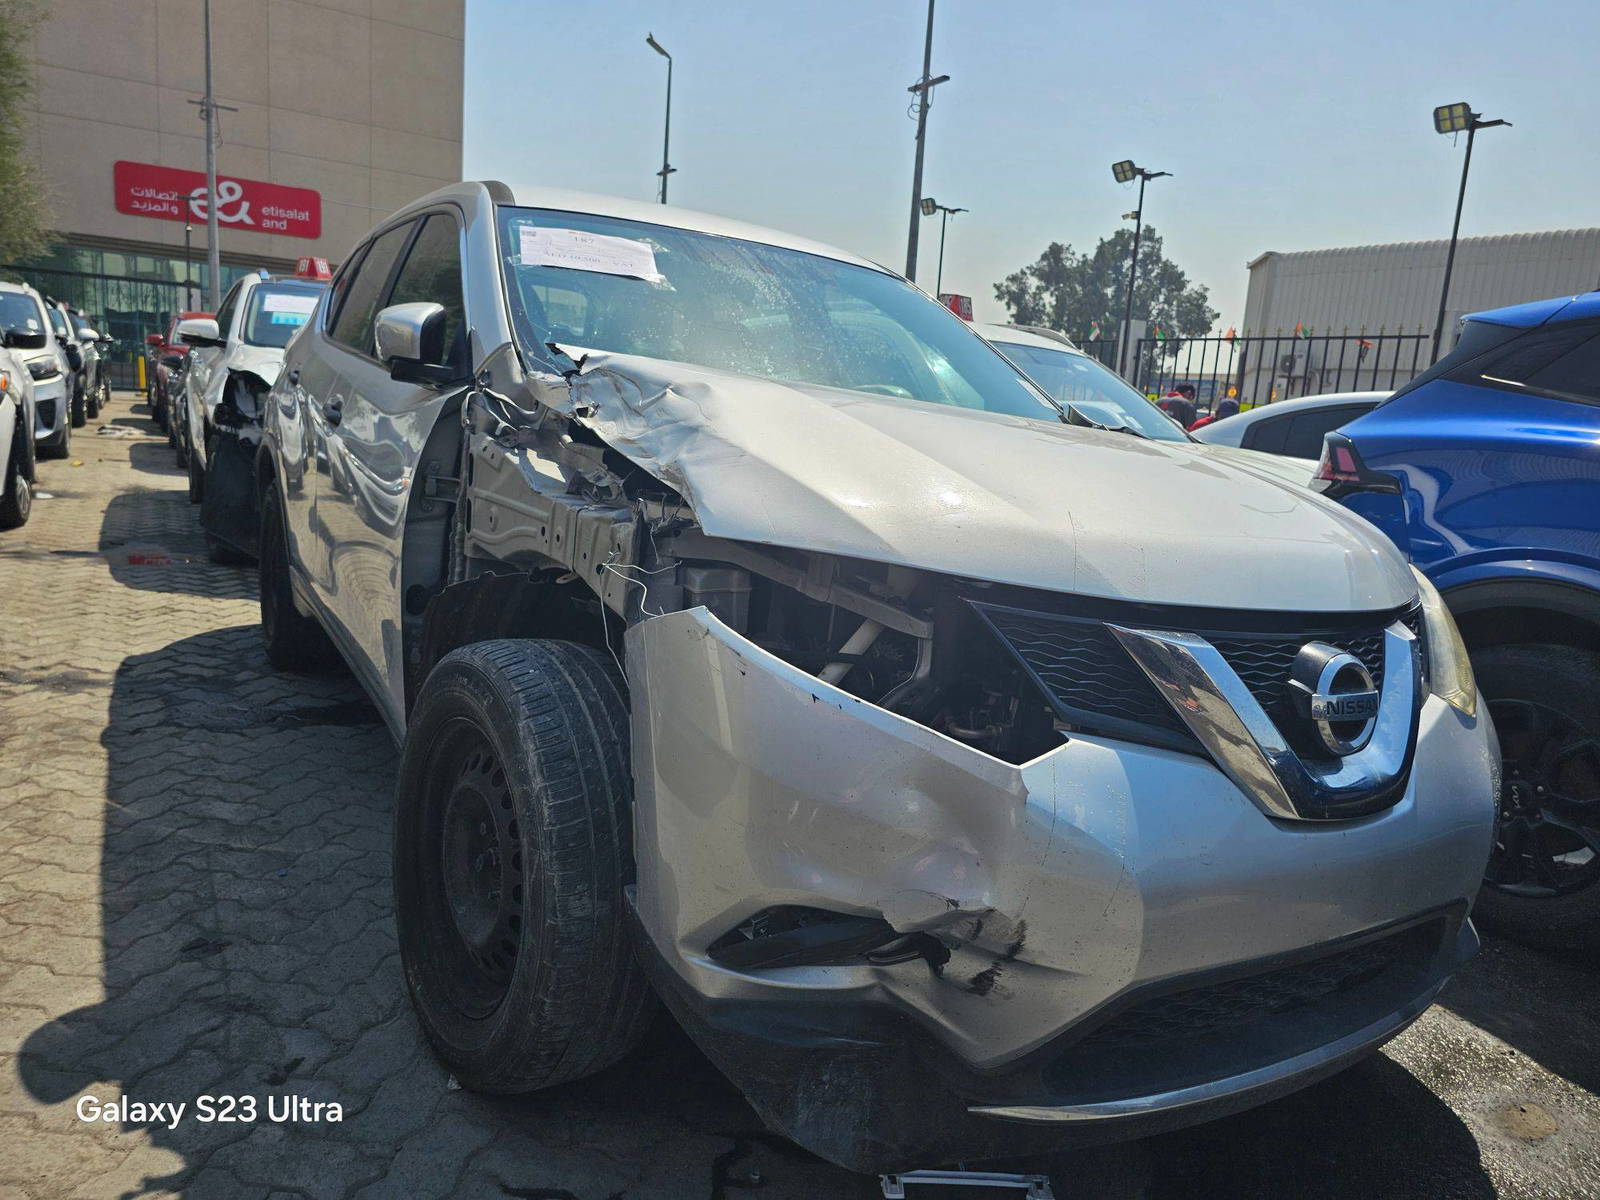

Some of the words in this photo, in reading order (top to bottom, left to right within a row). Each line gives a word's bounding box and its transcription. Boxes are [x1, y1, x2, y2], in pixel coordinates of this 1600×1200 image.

[262, 206, 310, 221] etisalat
[262, 218, 288, 230] and
[1326, 699, 1378, 715] NISSAN
